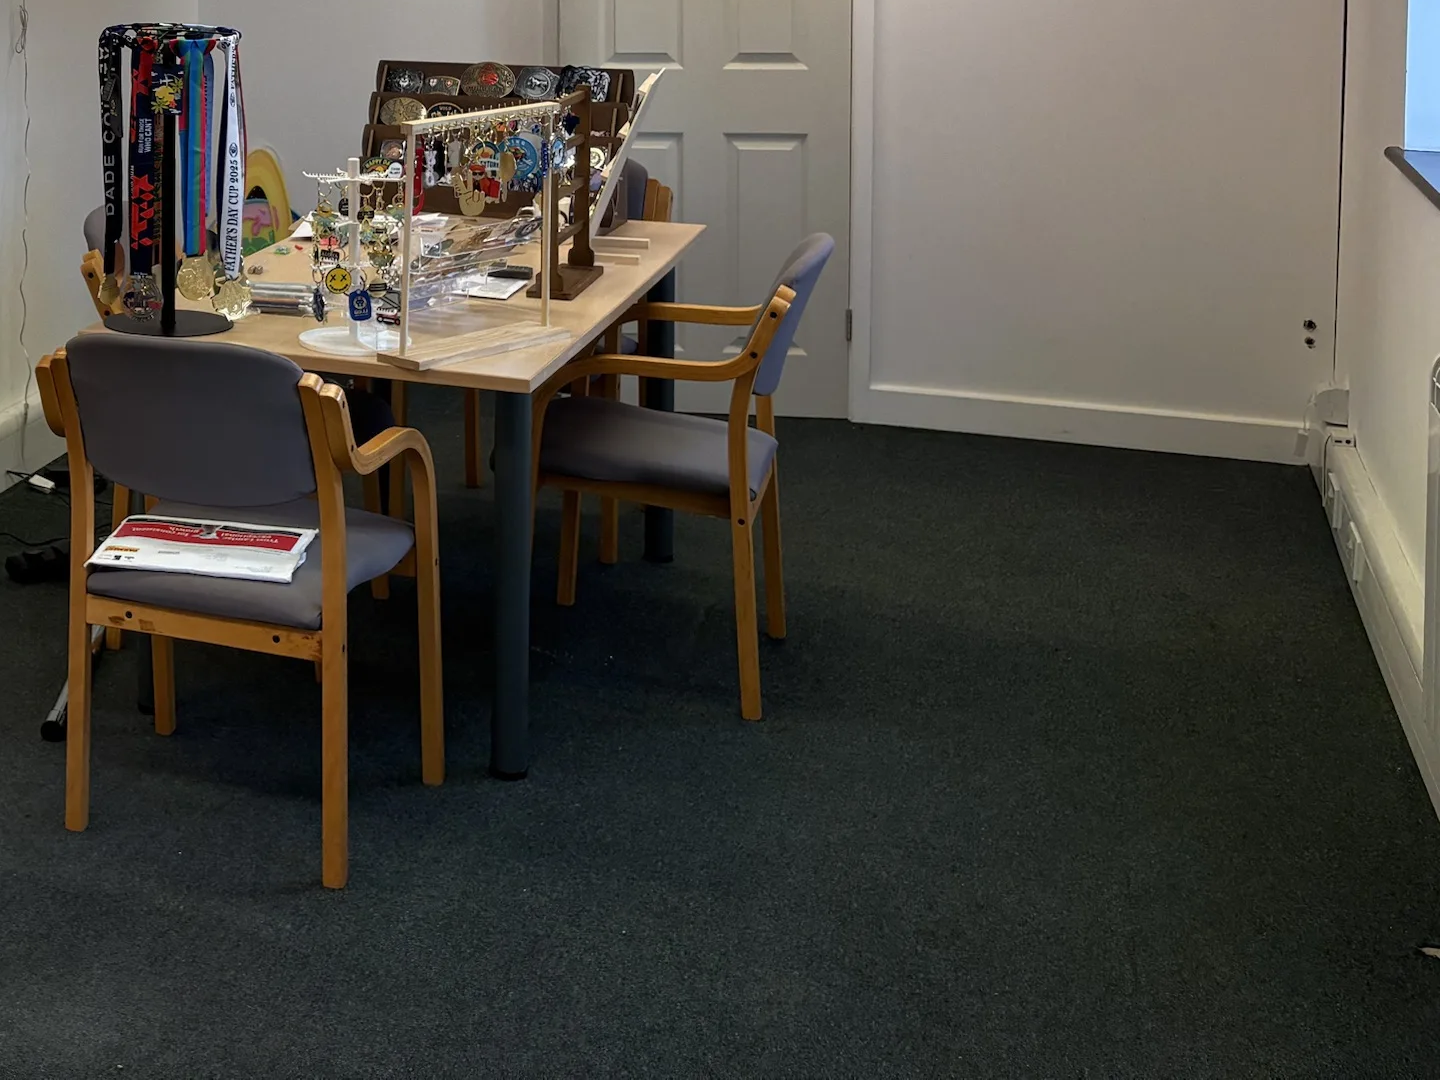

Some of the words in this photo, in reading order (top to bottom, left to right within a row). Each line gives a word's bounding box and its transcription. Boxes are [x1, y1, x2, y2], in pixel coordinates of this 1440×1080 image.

[144, 118, 152, 137] CAN'T
[144, 137, 152, 153] WHO
[229, 159, 239, 184] 2025
[103, 154, 116, 216] DADE
[228, 185, 239, 205] CUP
[227, 206, 239, 226] DAY
[224, 227, 238, 272] FATHER'S
